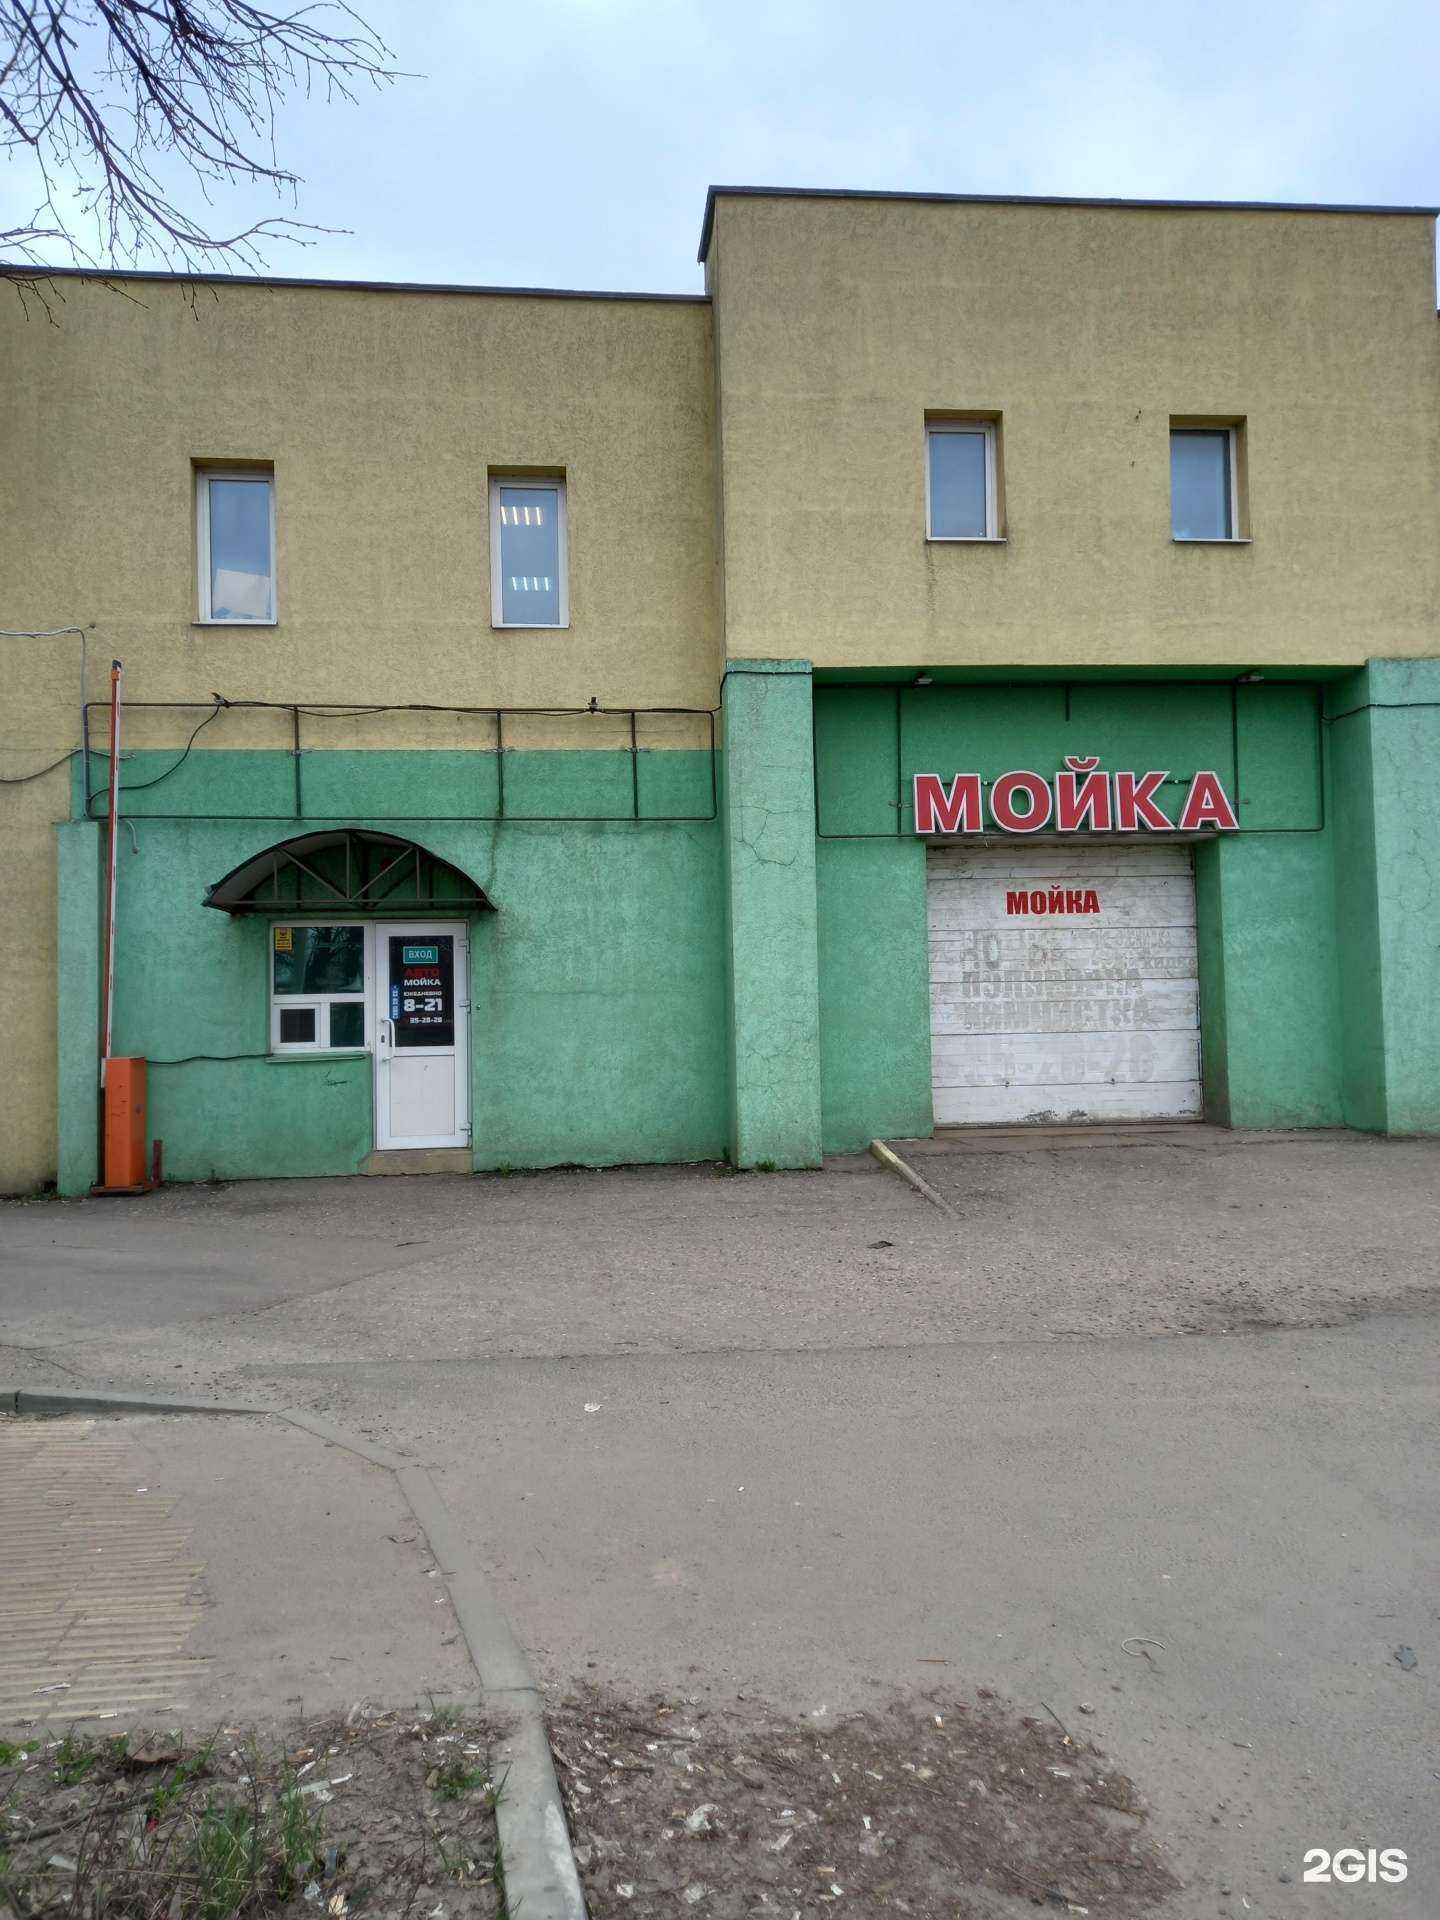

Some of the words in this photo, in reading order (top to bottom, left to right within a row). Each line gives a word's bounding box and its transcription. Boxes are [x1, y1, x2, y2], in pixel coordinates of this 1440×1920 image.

[913, 756, 1240, 833] МОЙКА
[1006, 885, 1101, 915] МОЙКА
[408, 950, 433, 960] ВХОД
[404, 967, 440, 977] АВТО
[404, 977, 441, 985] МОЙКА
[404, 998, 442, 1011] 8-21
